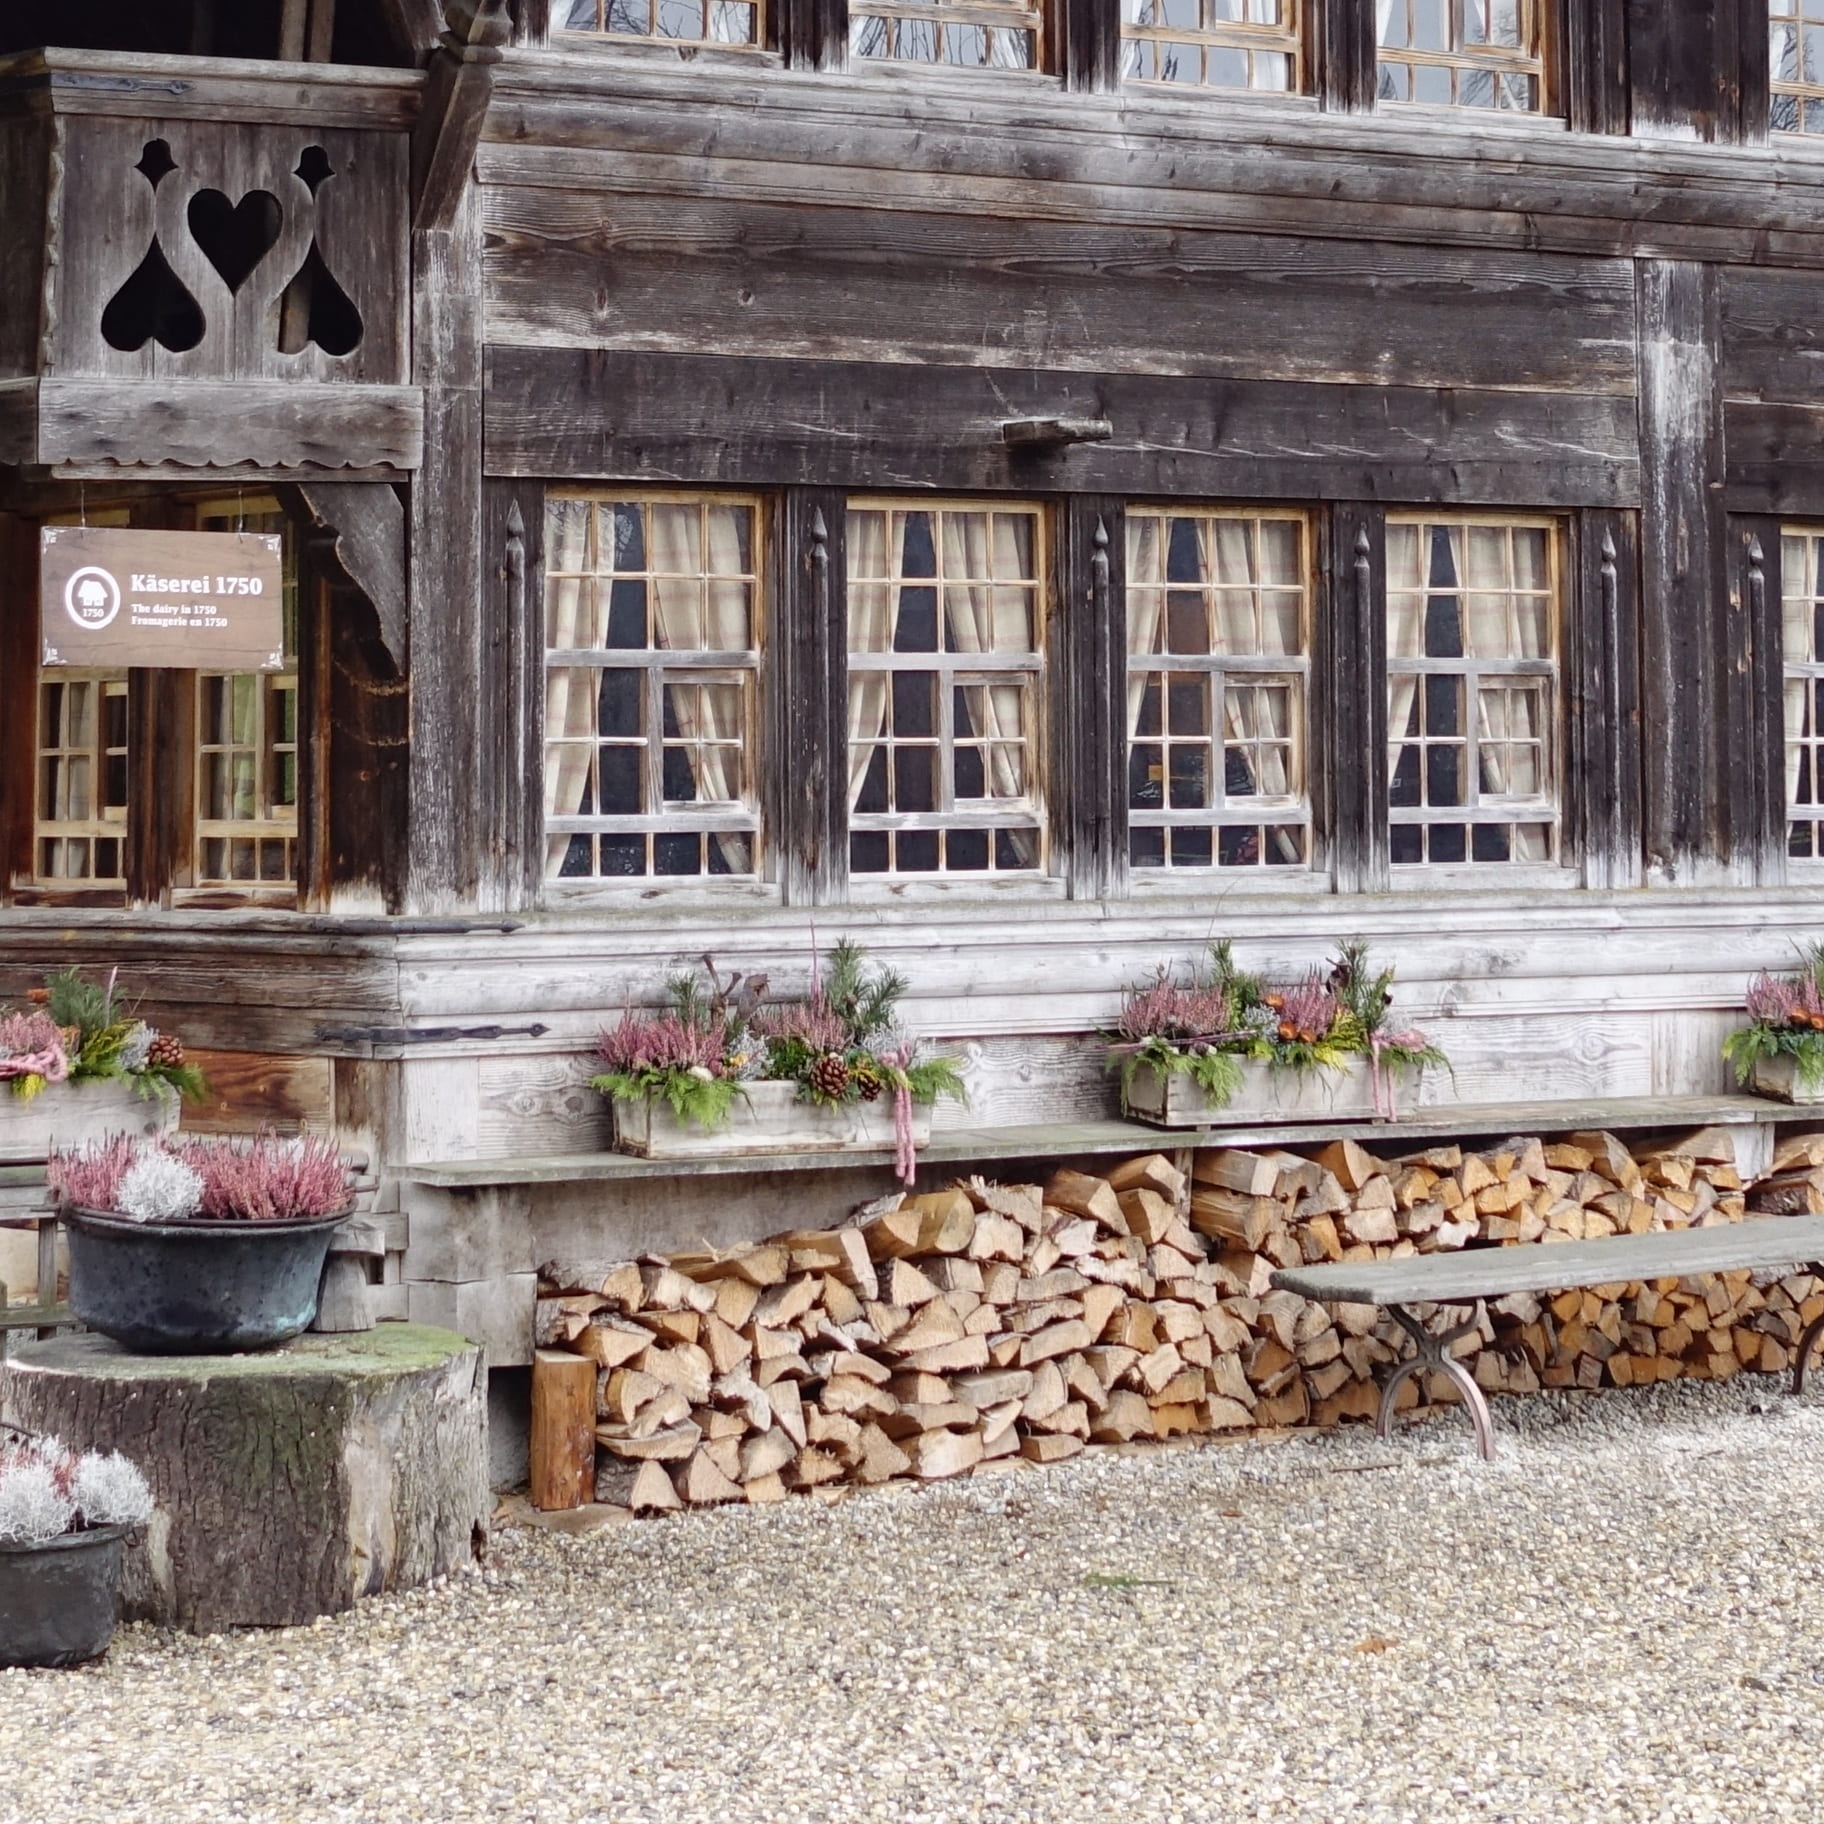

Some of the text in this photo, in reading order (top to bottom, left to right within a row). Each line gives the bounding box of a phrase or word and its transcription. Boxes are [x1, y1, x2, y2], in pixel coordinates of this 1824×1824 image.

[131, 574, 263, 595] Käserei 1750
[83, 608, 104, 618] 1750
[131, 604, 217, 615] The dairy in 1750
[131, 616, 228, 627] Fromagerie en 1750
